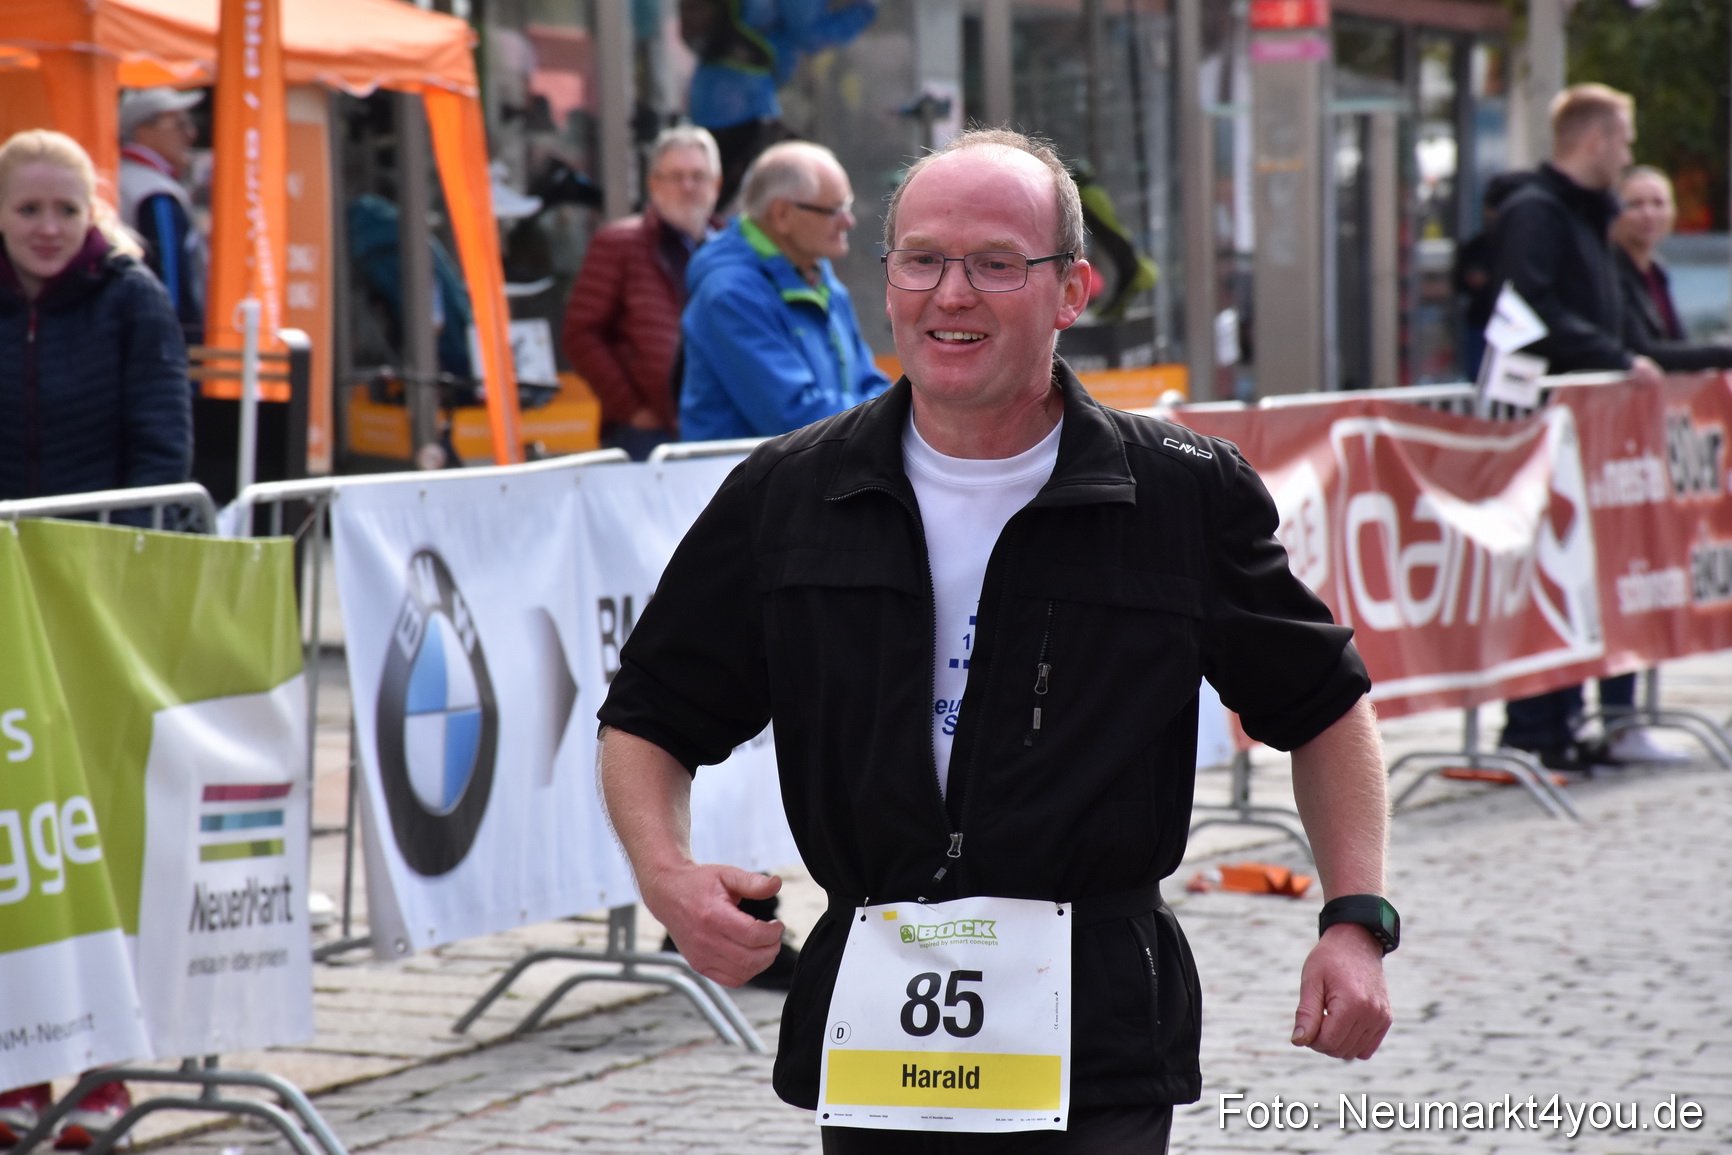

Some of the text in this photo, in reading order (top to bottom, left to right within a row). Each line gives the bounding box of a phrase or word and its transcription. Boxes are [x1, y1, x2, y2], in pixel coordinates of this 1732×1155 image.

[1163, 437, 1213, 460] CMP
[396, 553, 477, 662] BMW
[917, 919, 998, 942] BOCK
[919, 940, 940, 949] inspired
[969, 938, 999, 947] concepts
[900, 969, 985, 1039] 85
[902, 1063, 980, 1090] Harald
